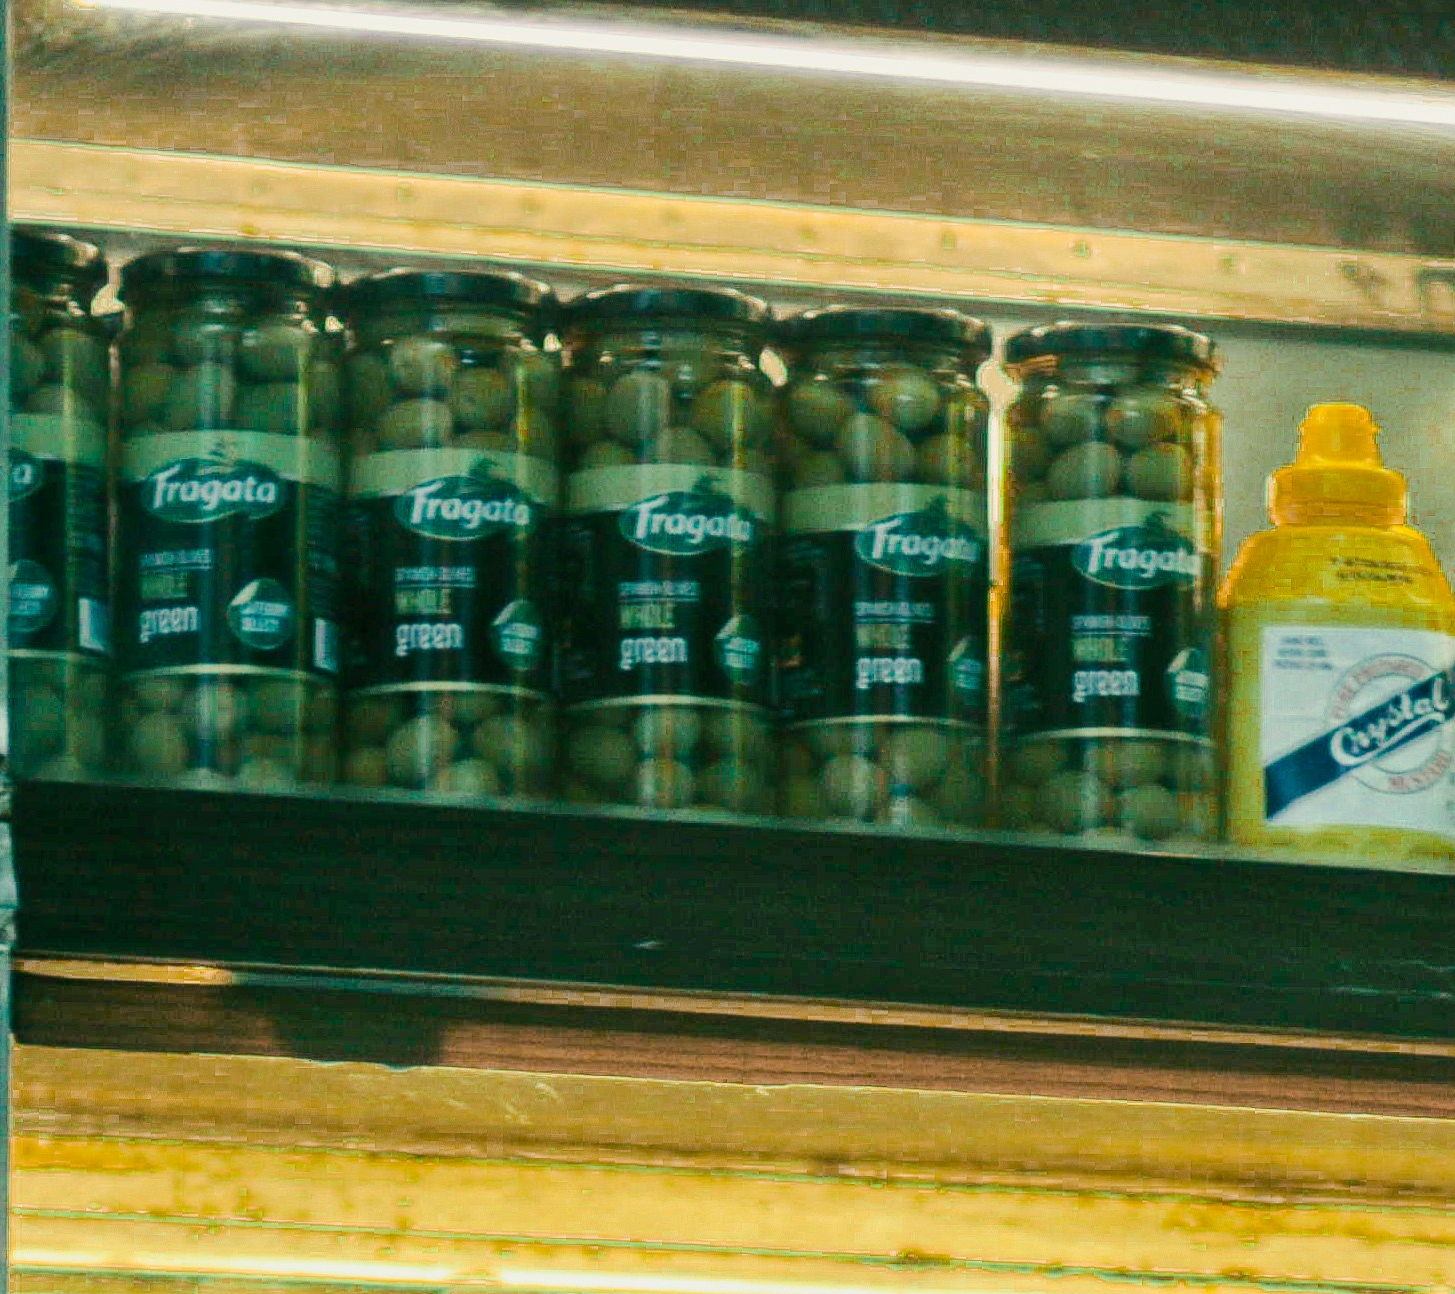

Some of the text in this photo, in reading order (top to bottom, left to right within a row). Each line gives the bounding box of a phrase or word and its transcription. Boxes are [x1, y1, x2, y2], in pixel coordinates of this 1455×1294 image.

[153, 463, 276, 510] Fragata
[407, 480, 531, 529] Fragata
[633, 495, 752, 545] Fragata
[140, 605, 200, 644] green
[395, 622, 464, 657] green
[618, 636, 688, 671] green
[856, 656, 924, 690] green
[1072, 669, 1141, 703] green
[1330, 676, 1450, 767] Crystal
